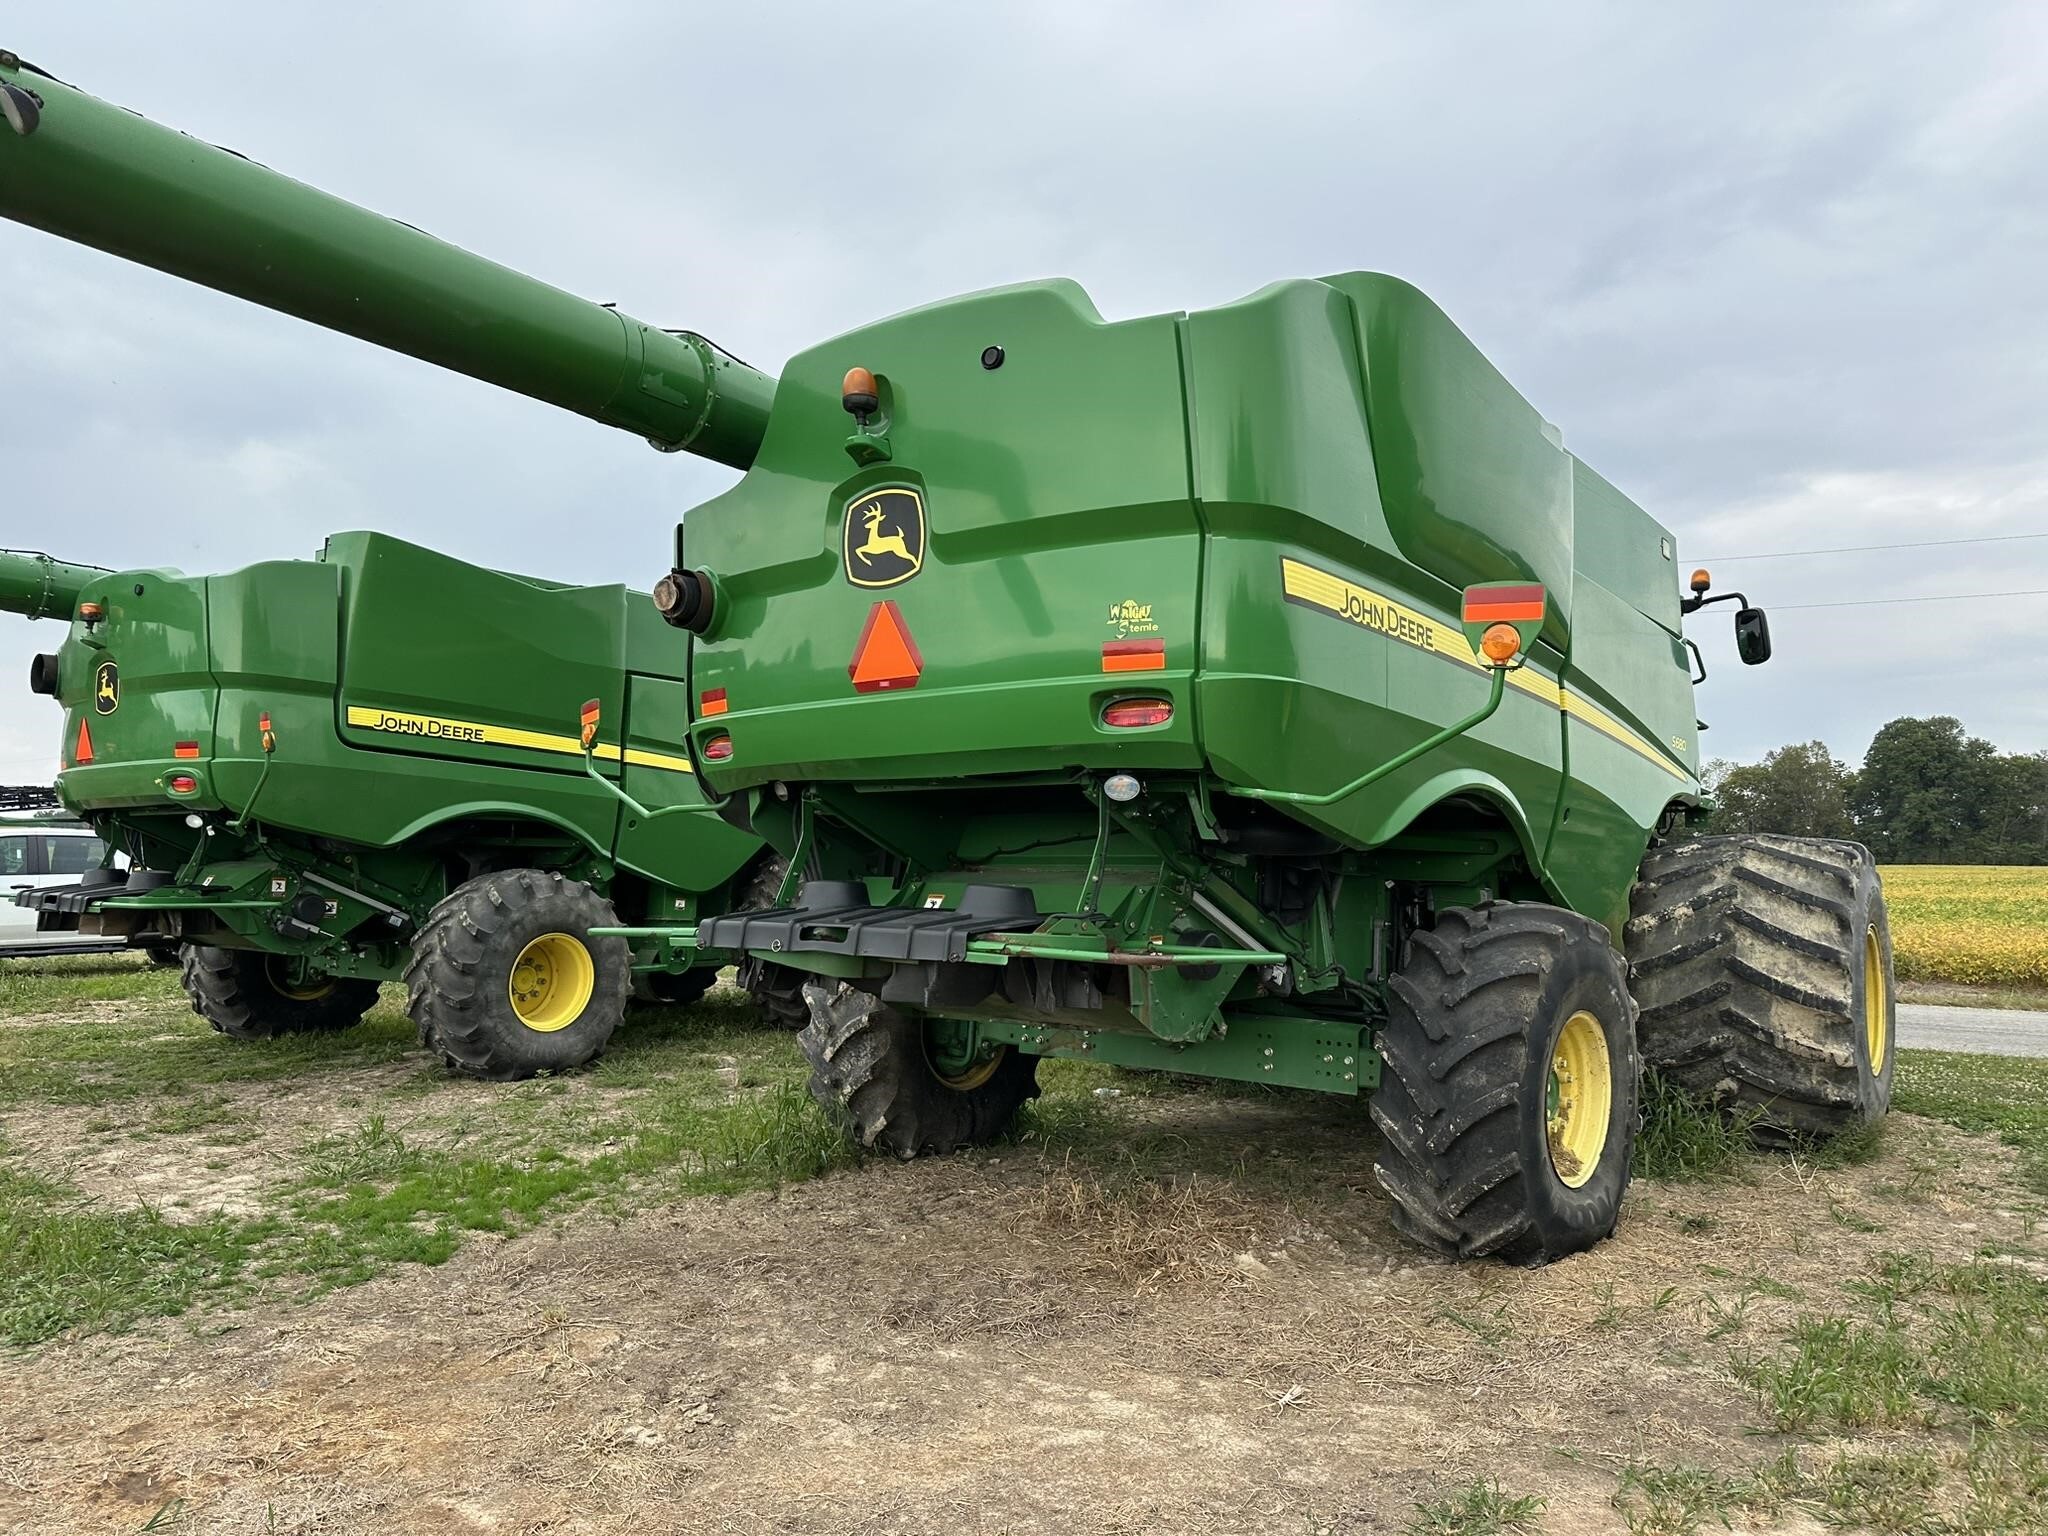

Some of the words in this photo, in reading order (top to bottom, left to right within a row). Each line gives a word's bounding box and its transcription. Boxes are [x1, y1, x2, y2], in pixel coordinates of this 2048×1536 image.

[1340, 588, 1385, 629] JOHN
[1387, 605, 1435, 649] DEERE
[373, 713, 424, 733] JOHN
[428, 720, 485, 741] DEERE
